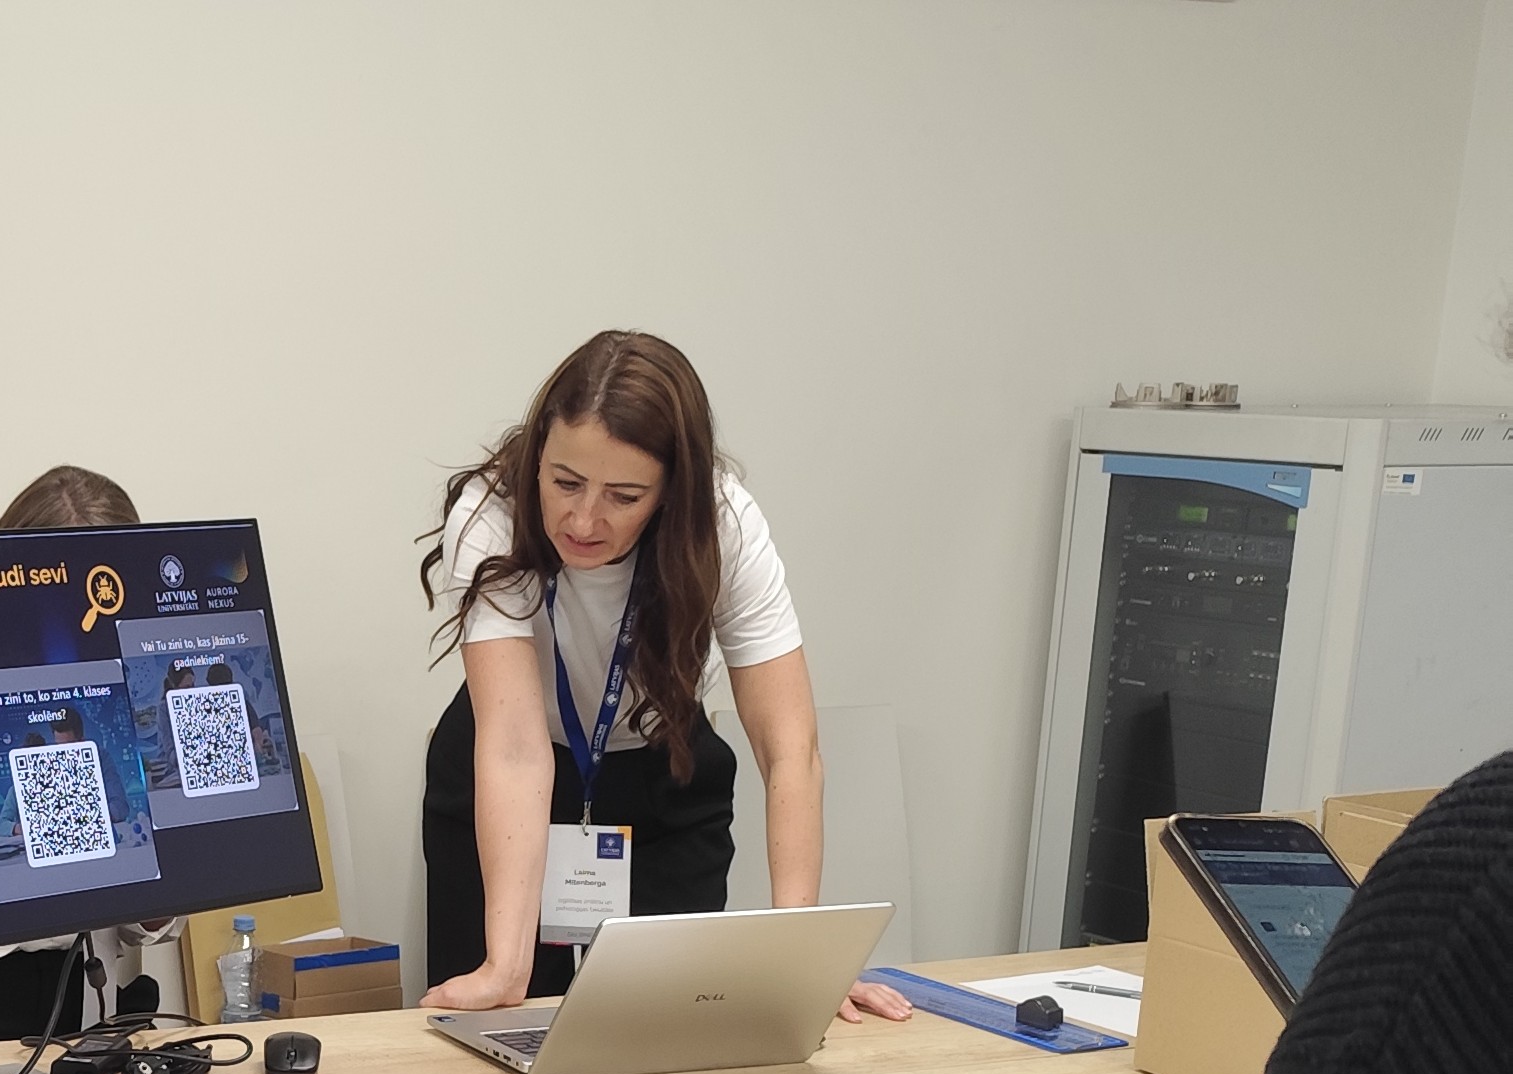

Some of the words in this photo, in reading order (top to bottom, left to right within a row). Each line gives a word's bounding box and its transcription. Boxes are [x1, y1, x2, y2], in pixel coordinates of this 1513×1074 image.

[29, 561, 69, 586] sevi
[154, 589, 199, 604] LATVIJAS
[205, 585, 240, 598] AURORA
[207, 597, 236, 609] NEXUS
[140, 640, 154, 653] Vai
[155, 639, 167, 651] Tu
[167, 637, 183, 650] zini
[183, 637, 196, 650] to,
[196, 635, 211, 649] kas
[211, 634, 237, 650] jāzina
[173, 652, 225, 670] gadniekiem?
[4, 692, 21, 706] zini
[22, 692, 37, 704] to,
[38, 689, 51, 702] ko
[52, 688, 72, 701] zina
[73, 689, 83, 699] 4.
[82, 685, 112, 698] klases
[27, 708, 67, 724] skolēns?
